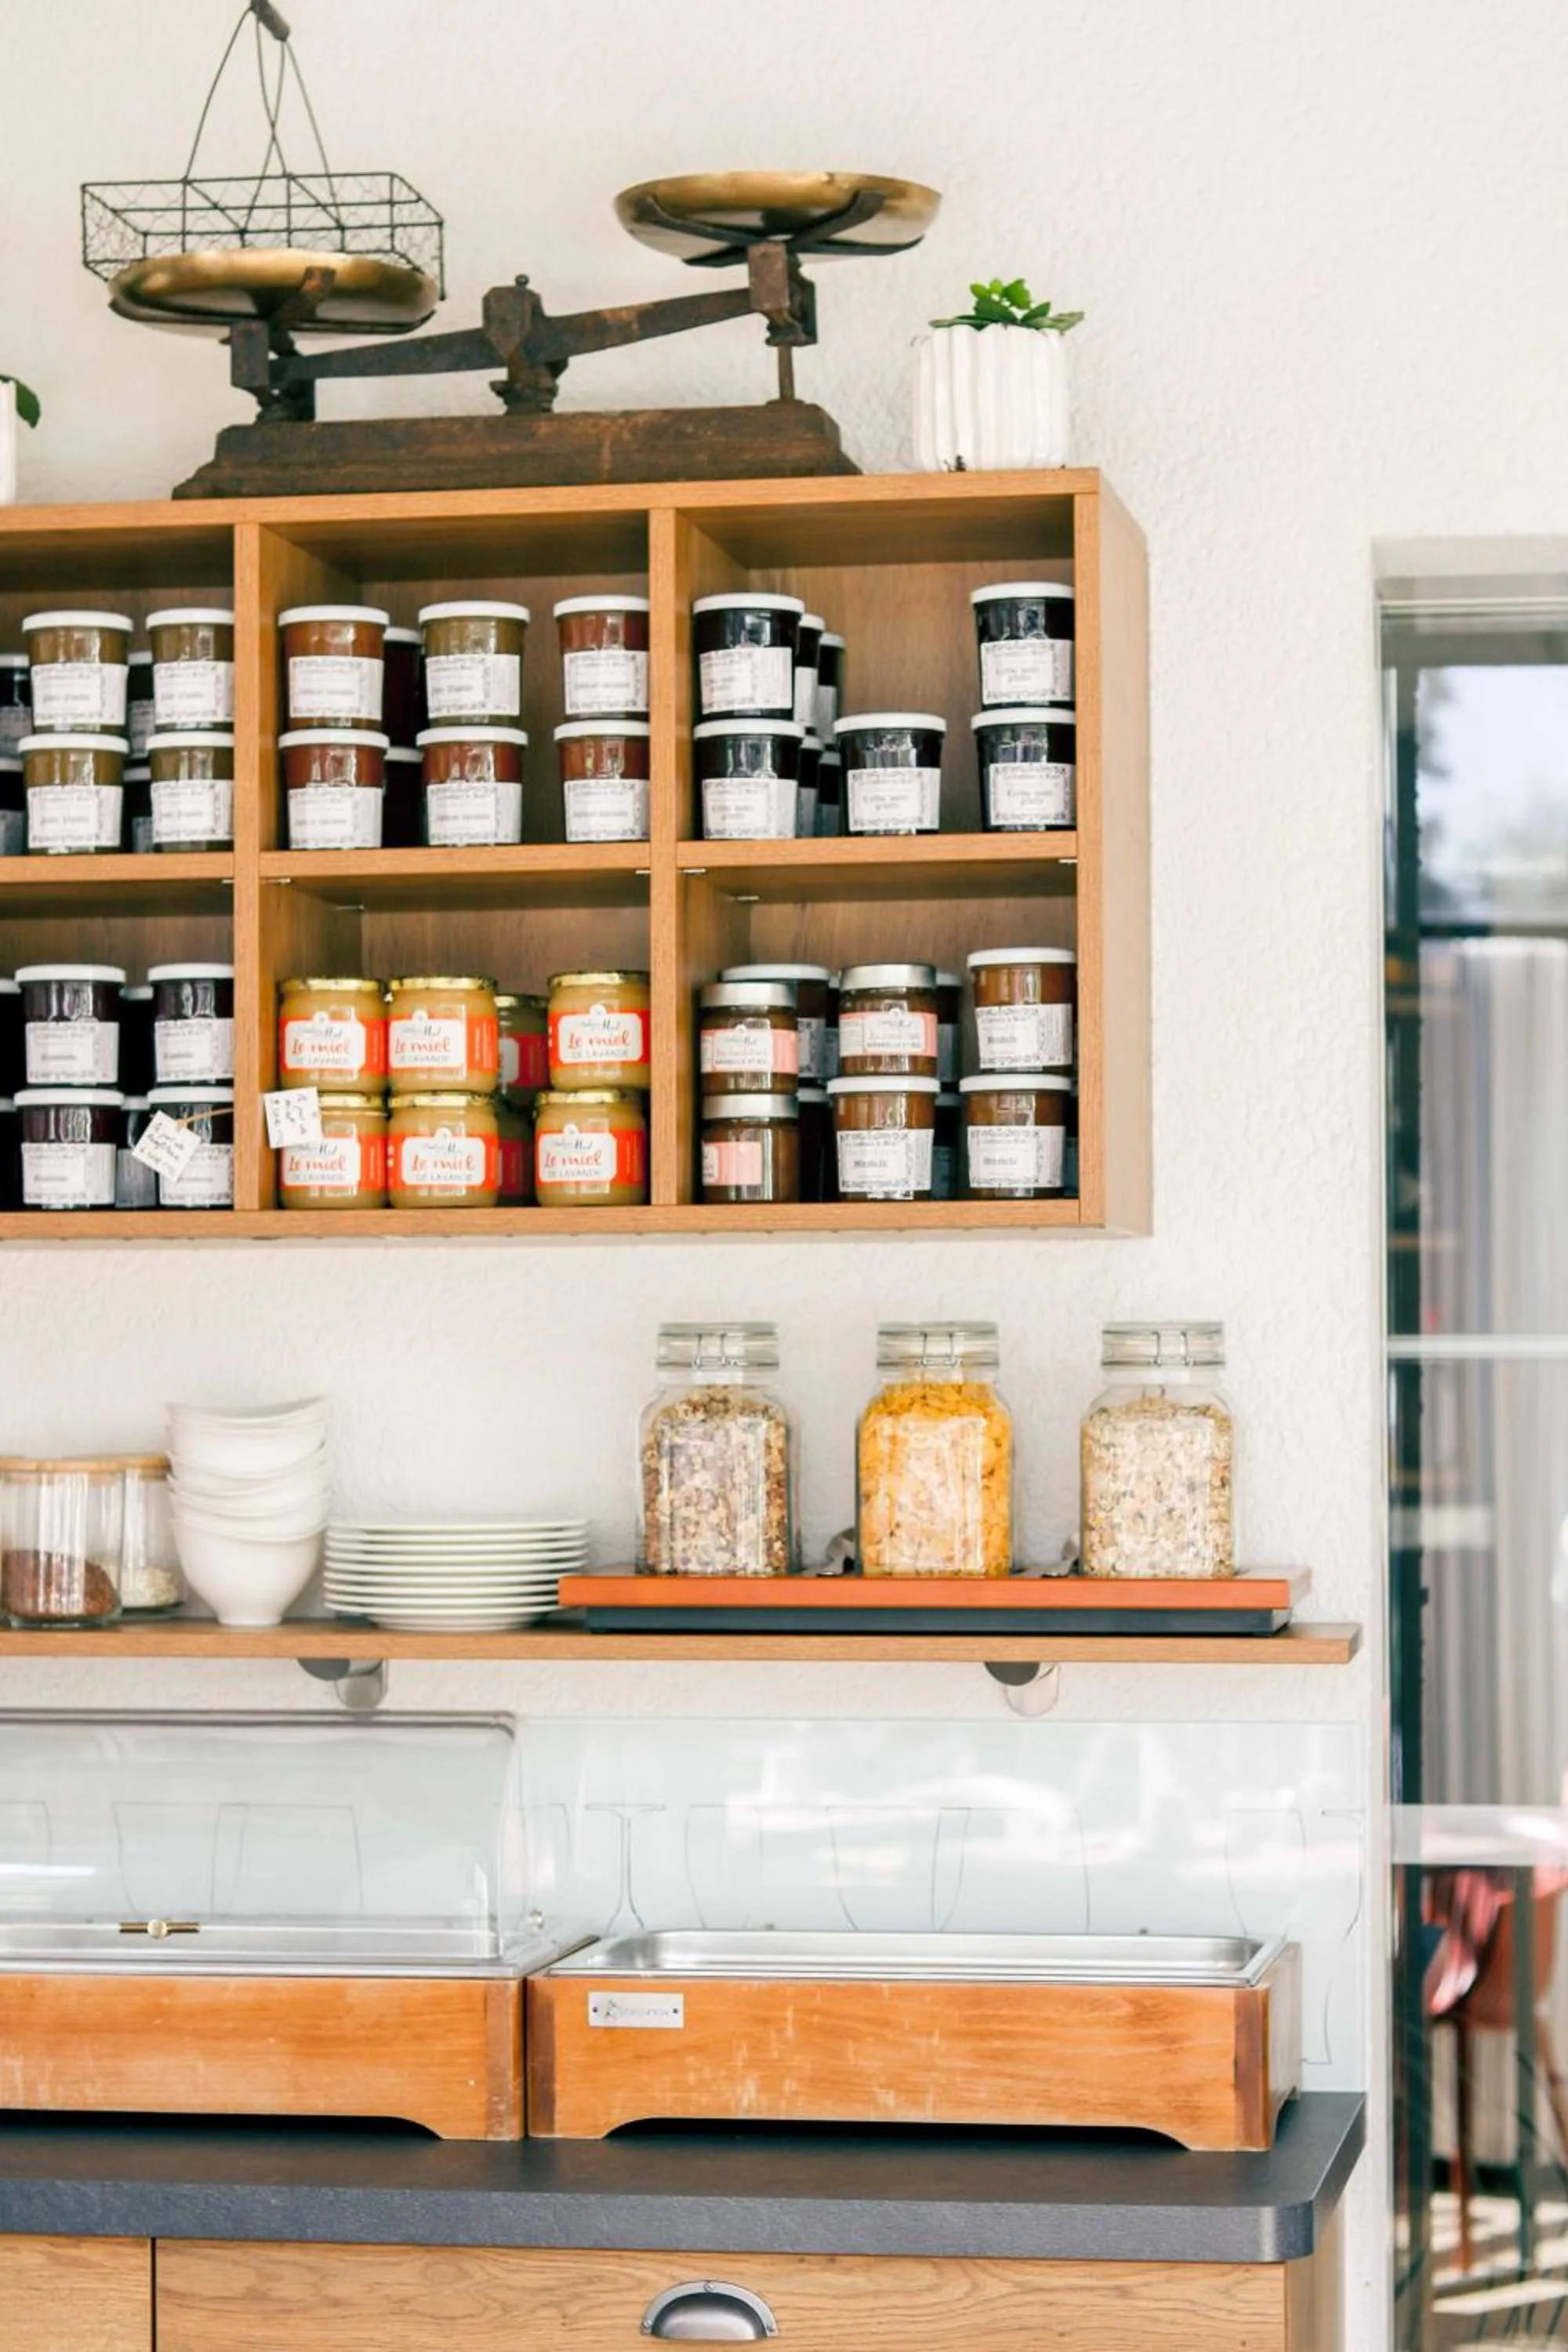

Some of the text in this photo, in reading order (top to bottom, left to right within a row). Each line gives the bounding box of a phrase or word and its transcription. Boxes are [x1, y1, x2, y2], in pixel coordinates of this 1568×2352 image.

[292, 1037, 350, 1054] Le miel
[394, 1035, 451, 1054] Le miel
[568, 1029, 630, 1049] Le miel
[289, 1154, 347, 1171] Le miel
[412, 1154, 475, 1171] Le miel
[544, 1149, 602, 1167] Le miel
